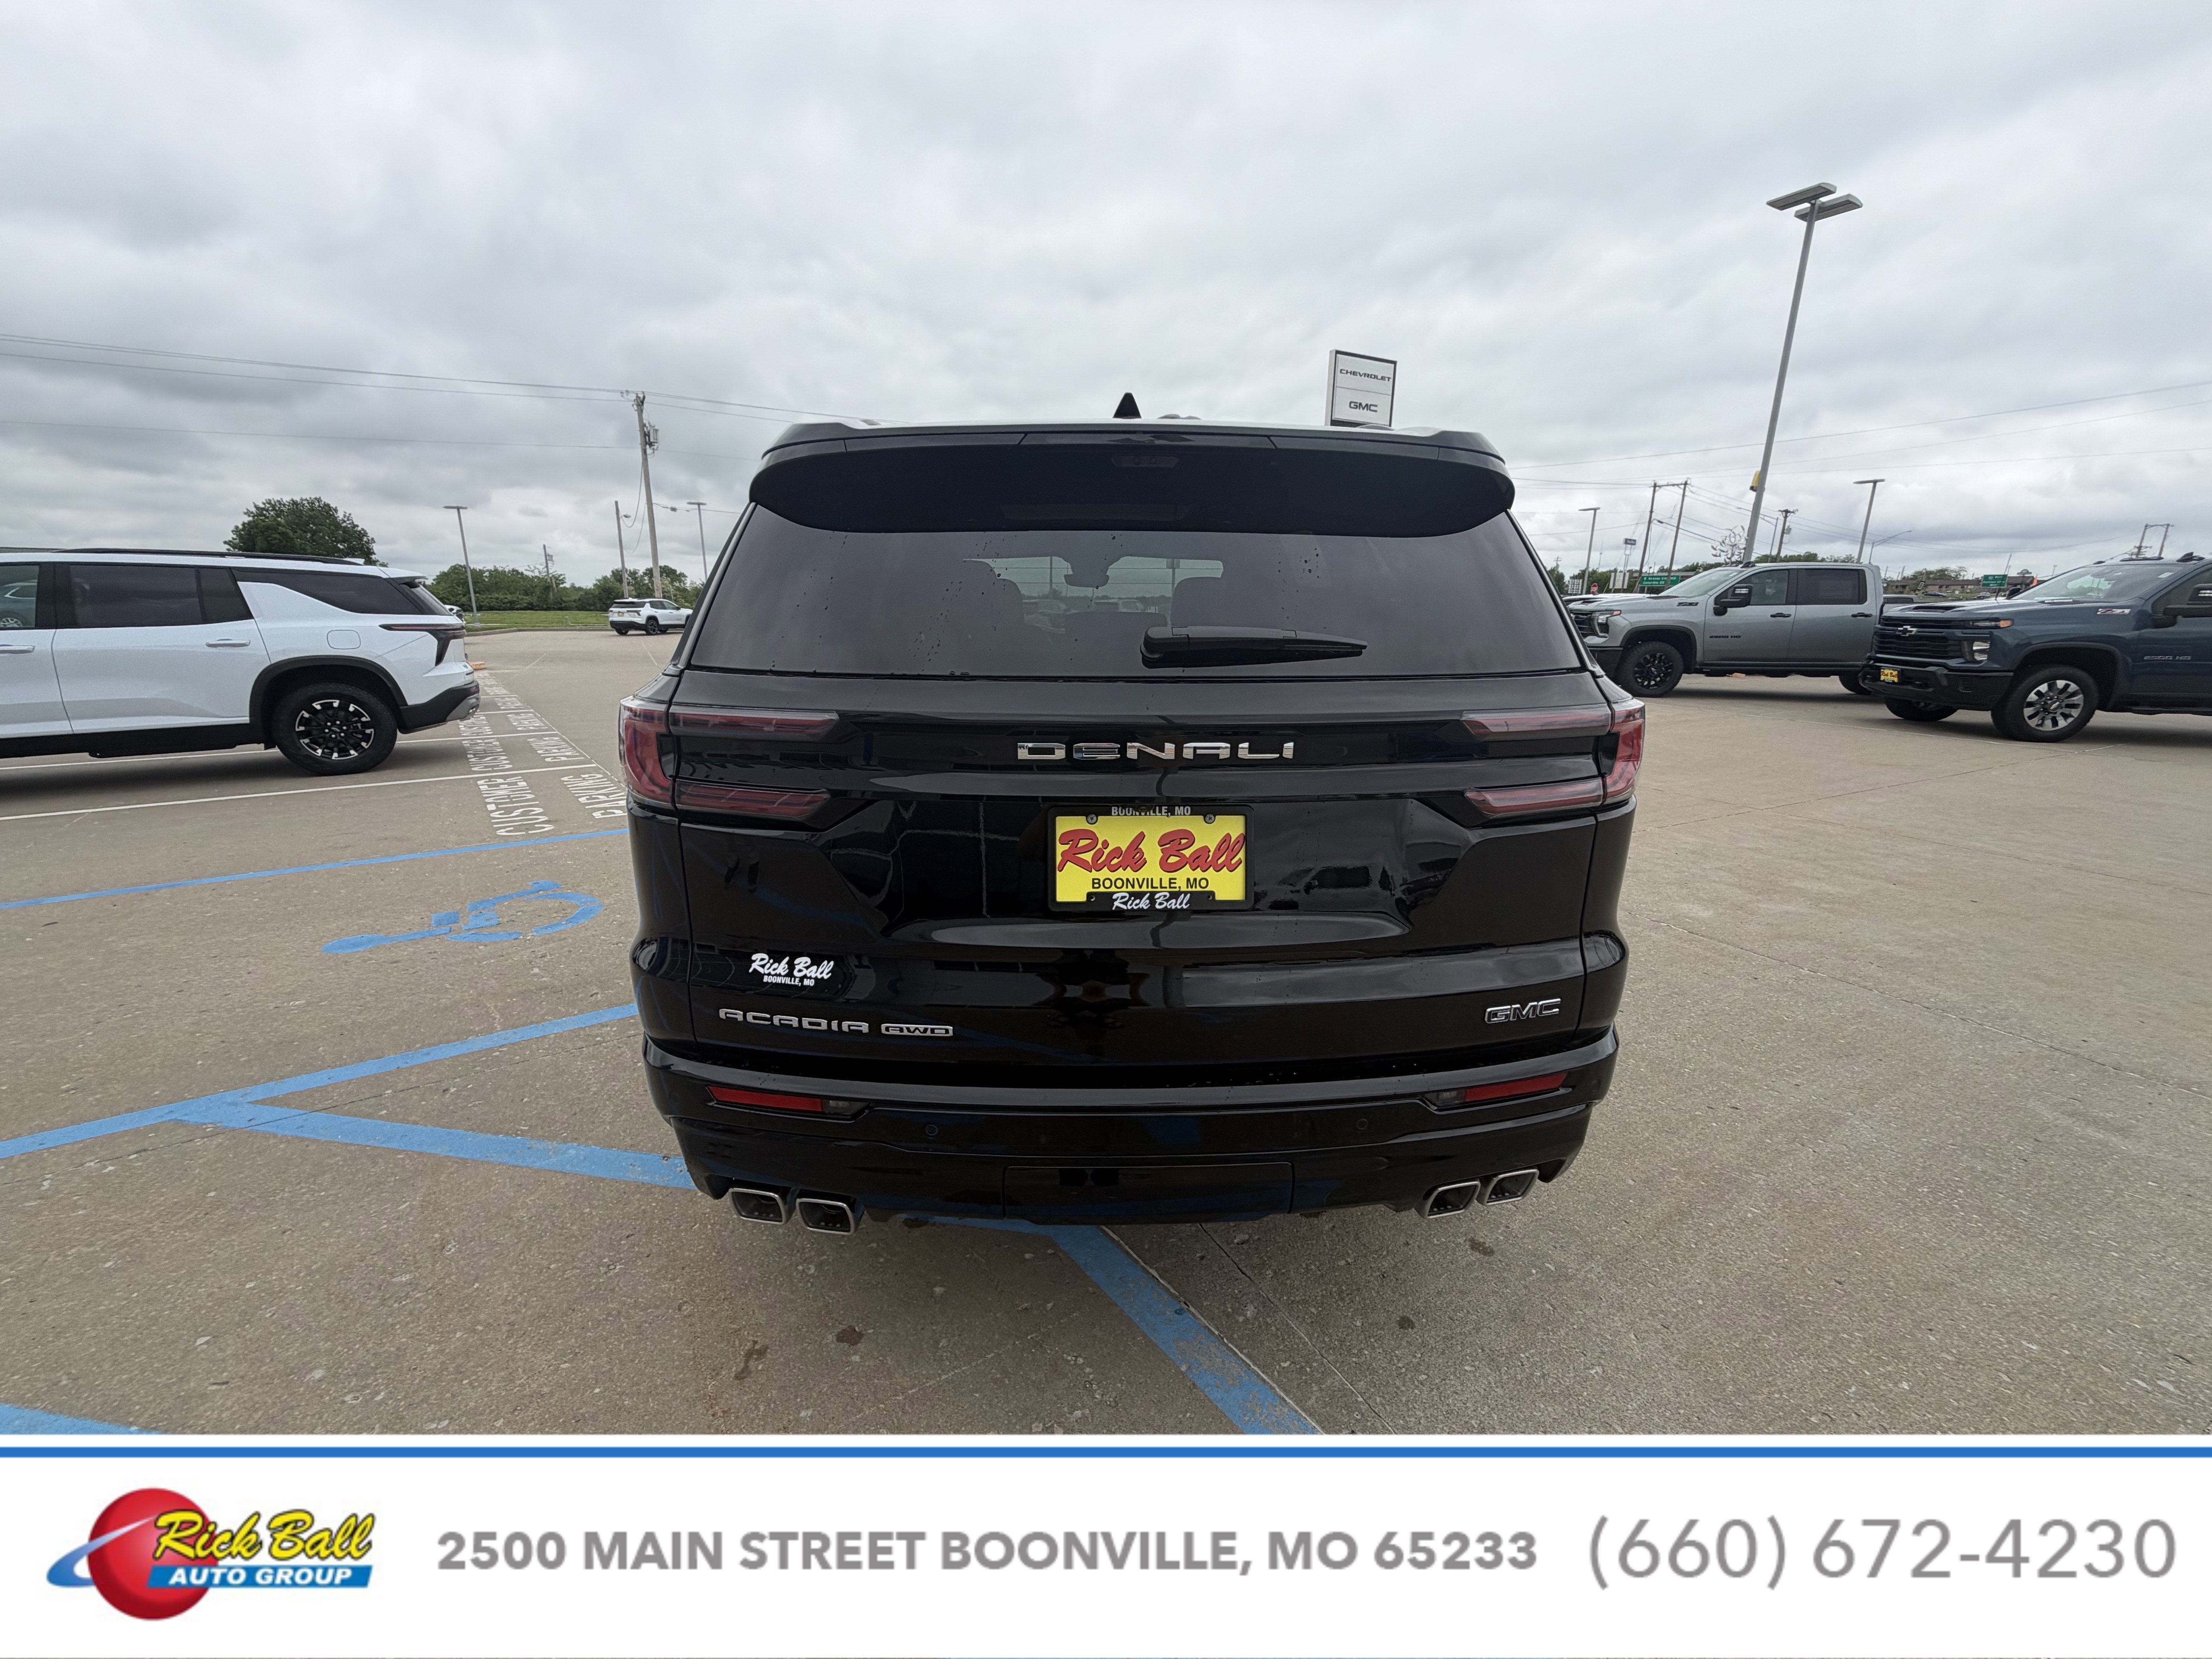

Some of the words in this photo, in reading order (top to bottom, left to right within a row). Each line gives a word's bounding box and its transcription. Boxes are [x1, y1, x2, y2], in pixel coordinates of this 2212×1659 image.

[1340, 369, 1392, 382] CHEVROLET
[1349, 401, 1378, 412] GMC
[462, 738, 513, 771] CUSTOMER
[1017, 742, 1294, 759] DENALI
[477, 776, 555, 836] CUSTOMER
[560, 774, 628, 819] PARKING
[1175, 806, 1191, 816] MO
[1057, 828, 1147, 872] Rick
[1158, 829, 1245, 873] Ball
[1091, 878, 1181, 891] BOONVILLE,
[1186, 878, 1209, 889] MO
[1112, 892, 1151, 910] Rick
[1154, 891, 1190, 910] Ball
[749, 953, 789, 974] Rick
[793, 957, 834, 979] Ball
[763, 975, 802, 986] BOONVILLE,
[803, 978, 815, 986] MO
[719, 1008, 869, 1033] ACADIA
[883, 1025, 952, 1036] AWD
[1485, 998, 1561, 1024] GMC
